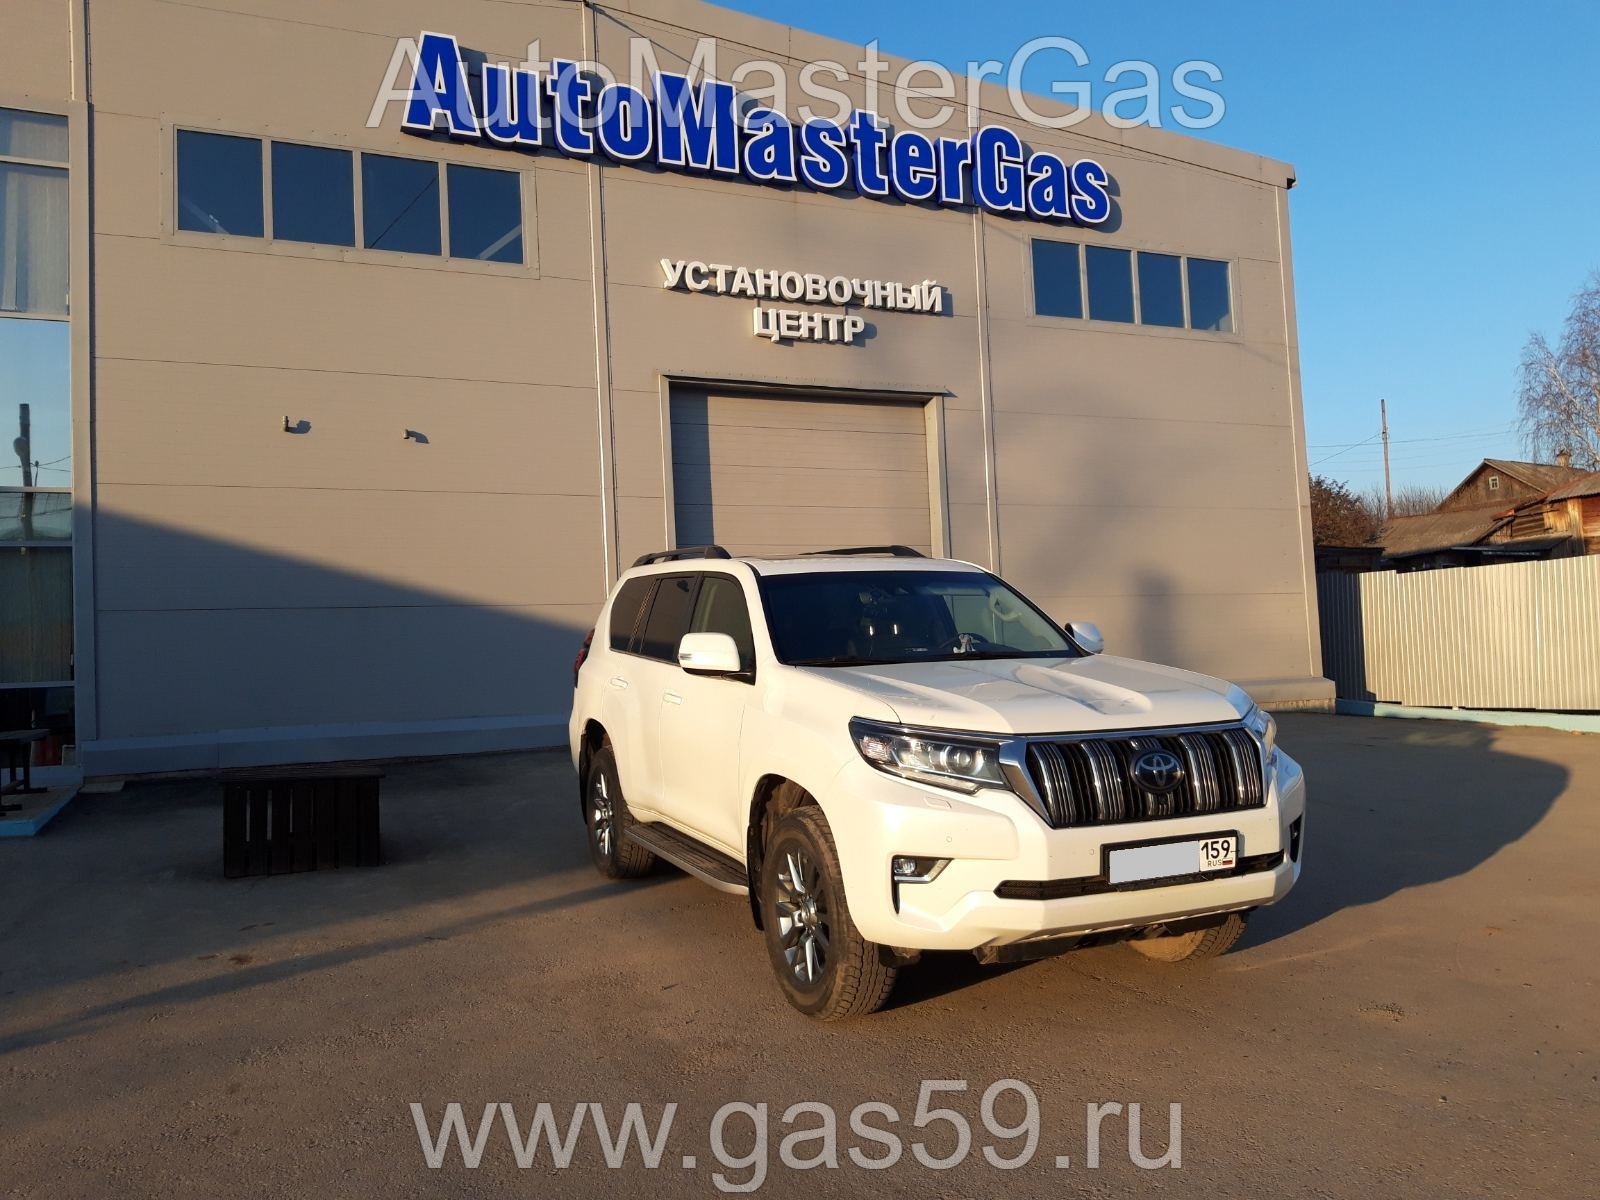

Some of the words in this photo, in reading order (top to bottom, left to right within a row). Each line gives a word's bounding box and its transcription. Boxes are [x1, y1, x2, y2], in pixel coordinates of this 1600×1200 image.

[402, 31, 1112, 226] AutoMasterGas
[660, 258, 943, 313] УСТАНОВОЧНЫЙ
[753, 307, 865, 343] ЦЕНТР
[1201, 839, 1231, 860] 159
[1207, 859, 1222, 867] RUS
